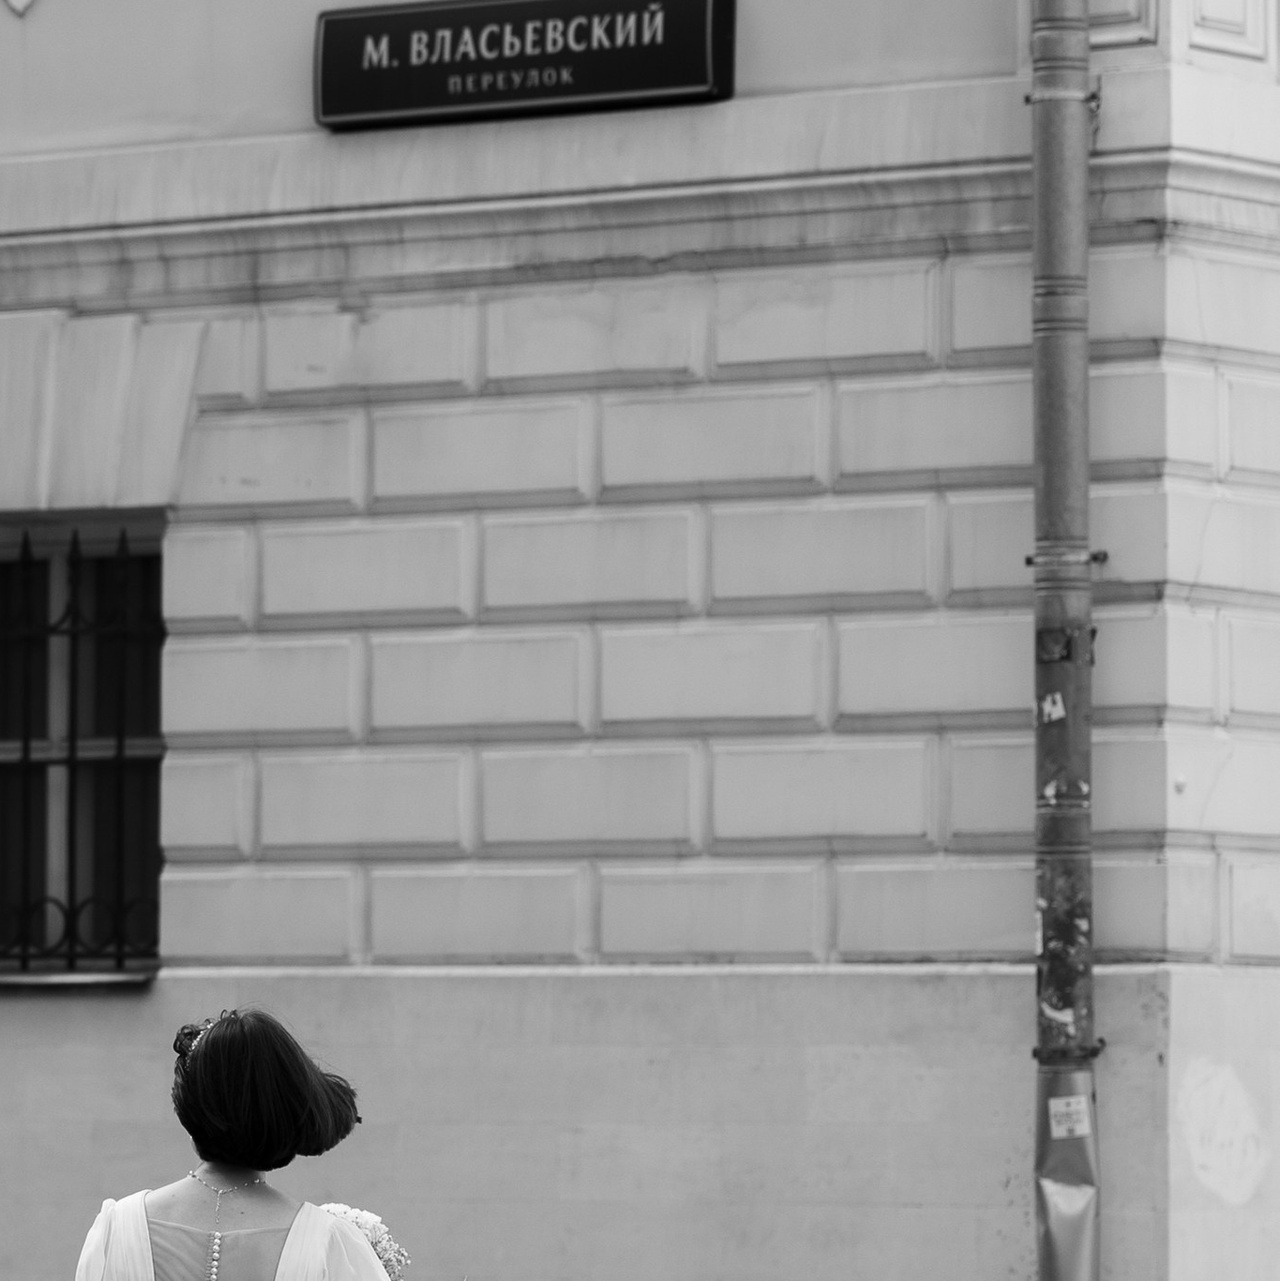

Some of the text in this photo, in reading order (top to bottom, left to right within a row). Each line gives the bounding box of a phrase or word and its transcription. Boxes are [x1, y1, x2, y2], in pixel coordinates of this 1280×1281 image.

[362, 2, 665, 70] М. ВЛАСЬЕВСКИЙ
[448, 66, 576, 96] ПЕРЕУЛОК
